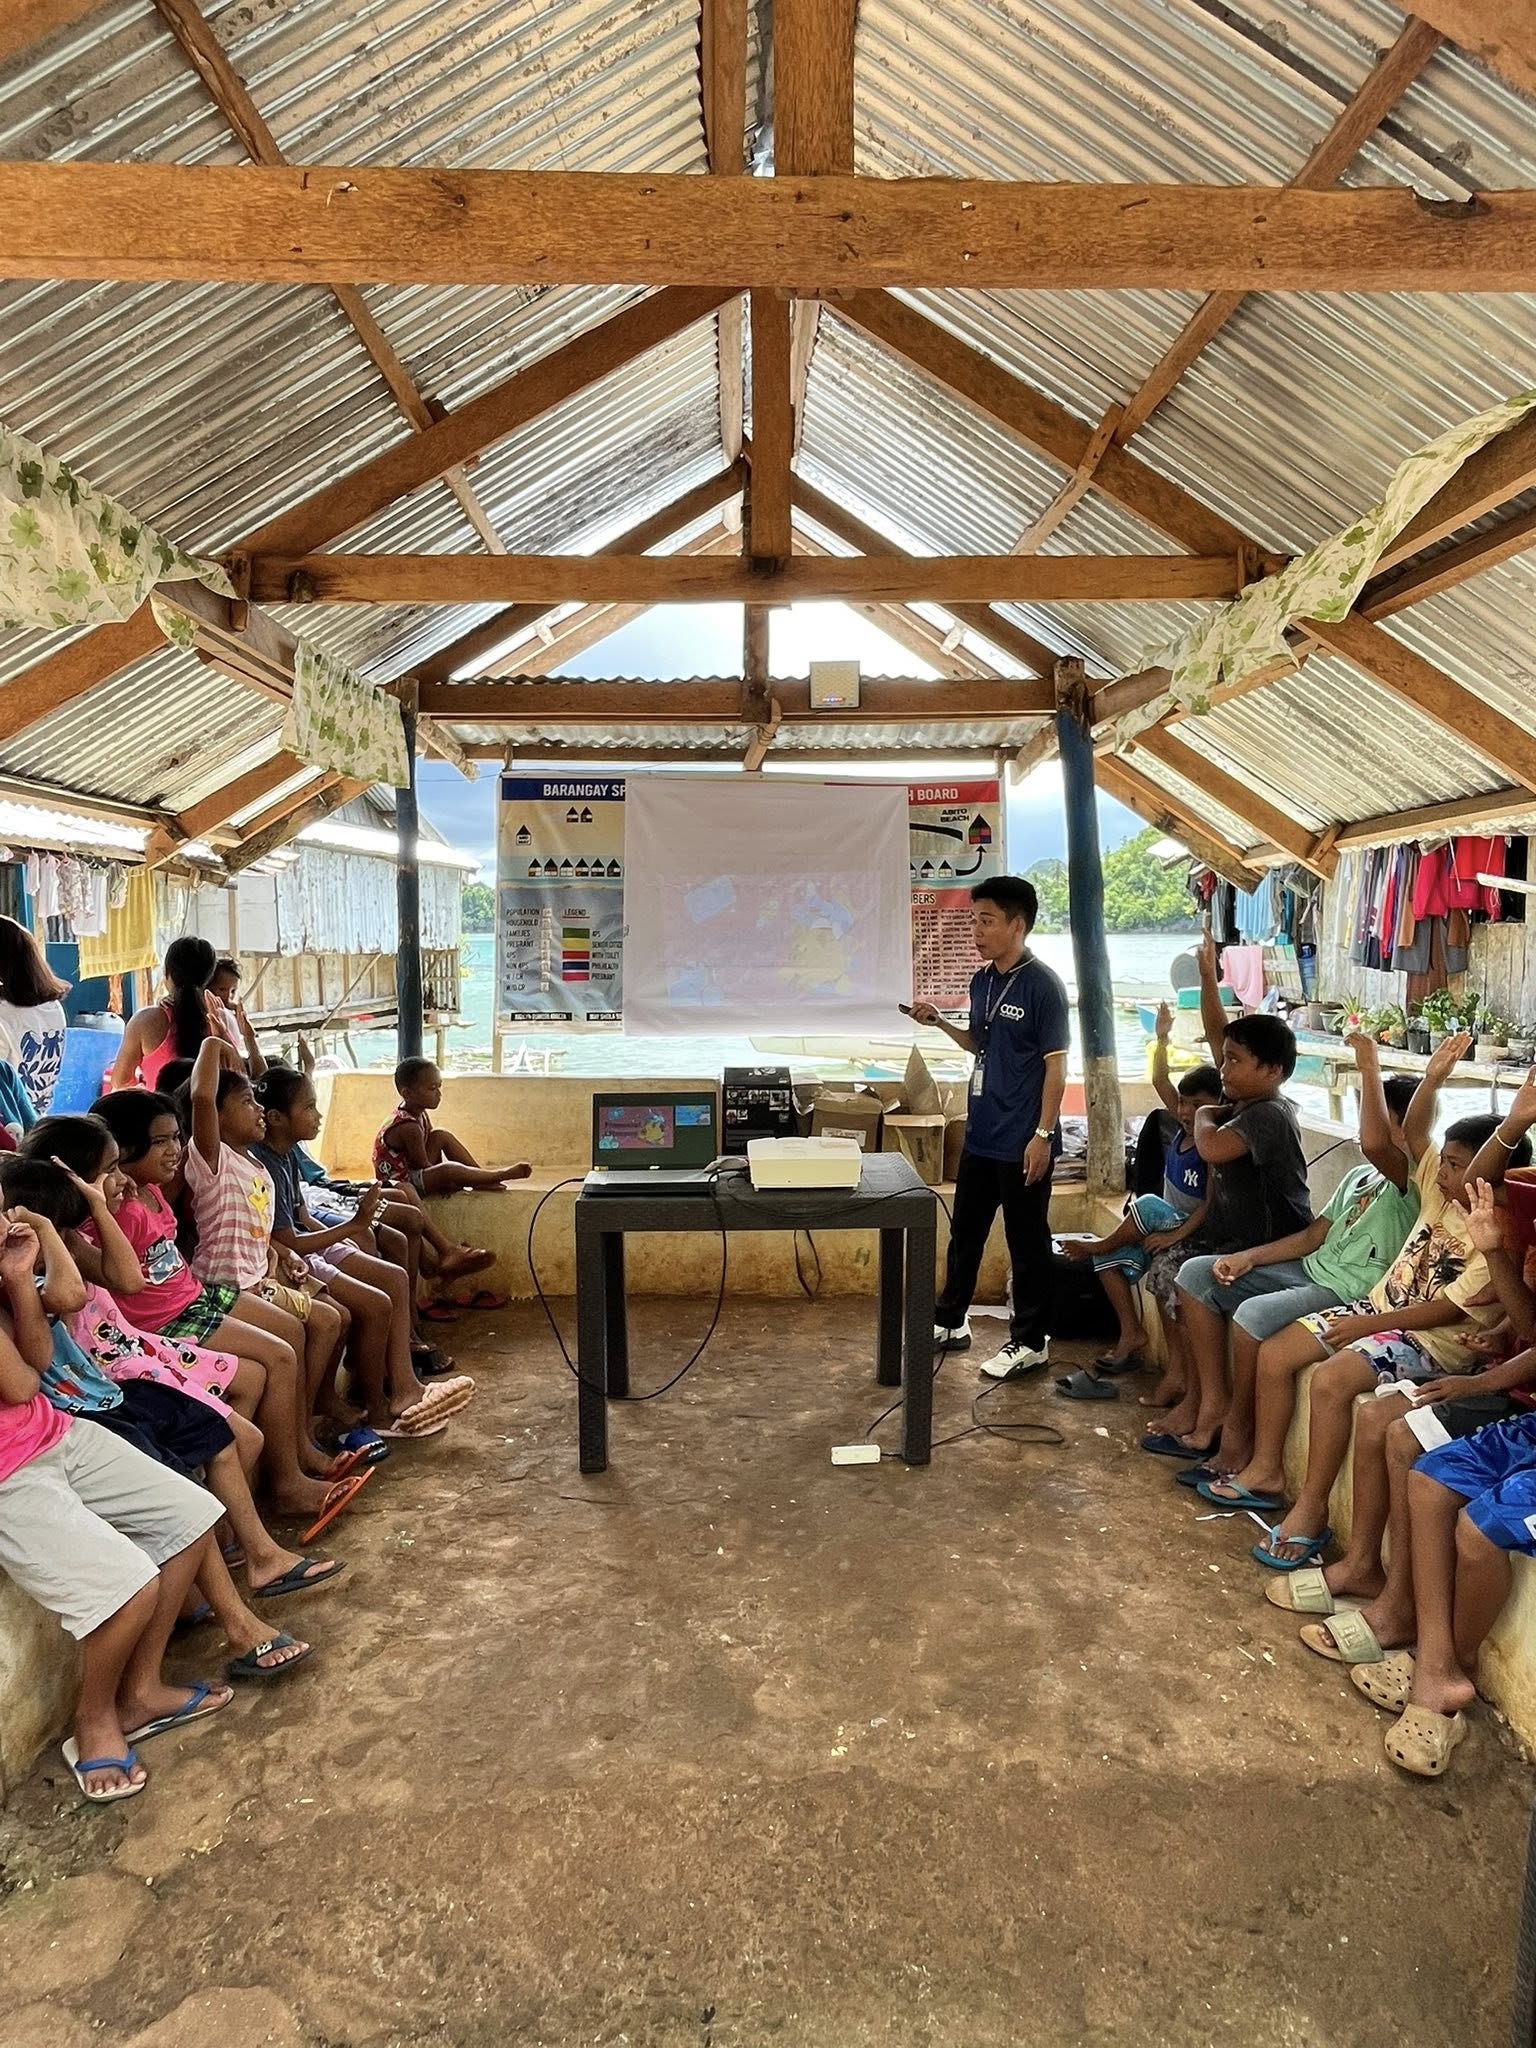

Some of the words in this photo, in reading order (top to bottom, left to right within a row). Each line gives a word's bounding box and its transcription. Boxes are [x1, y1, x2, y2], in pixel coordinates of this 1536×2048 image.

[543, 784, 608, 796] BARANGAY
[917, 788, 959, 801] BOARD
[941, 808, 968, 816] ABITO
[940, 815, 970, 823] BEACH
[506, 908, 540, 916] POPULATION
[564, 908, 586, 916] LEGEND
[506, 919, 539, 927] HOUSEHOLD
